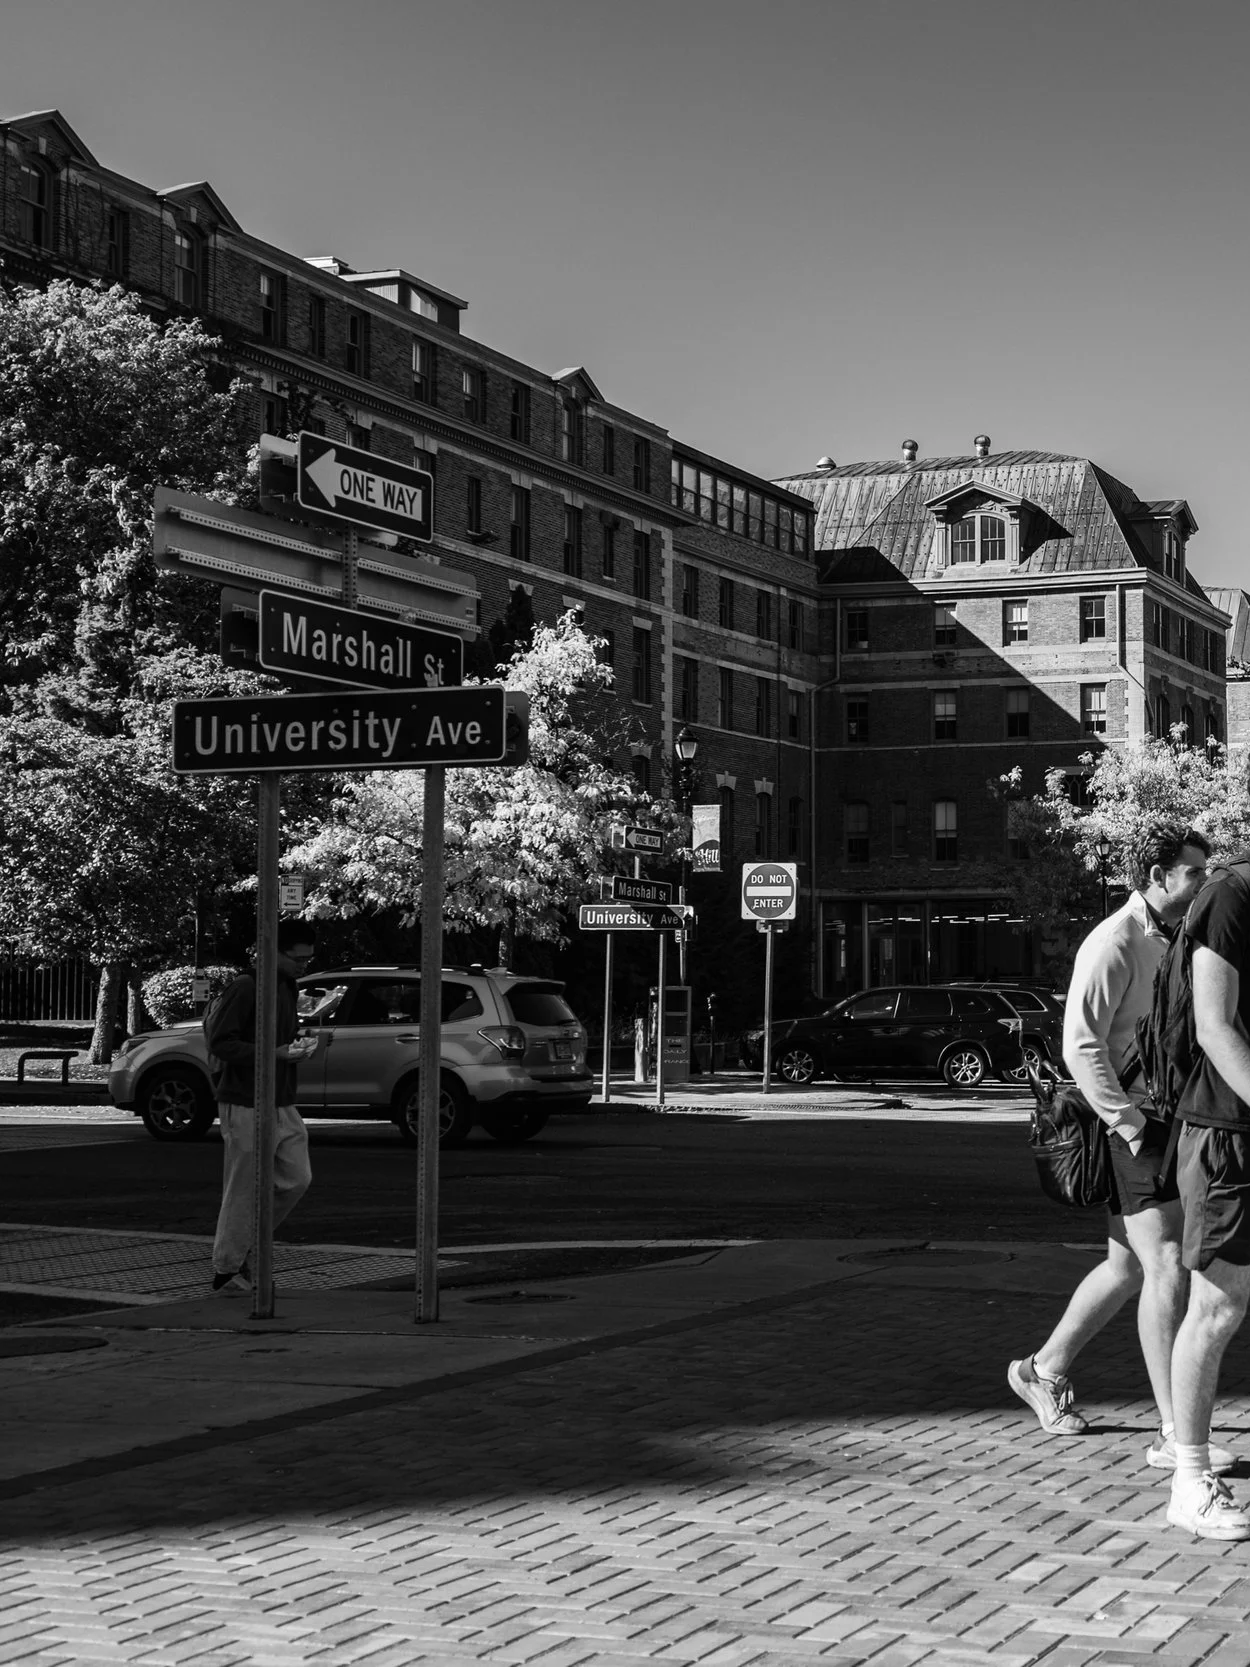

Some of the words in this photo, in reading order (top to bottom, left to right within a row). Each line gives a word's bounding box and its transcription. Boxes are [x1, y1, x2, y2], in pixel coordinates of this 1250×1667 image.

[339, 467, 376, 504] ONE
[382, 480, 418, 516] WAY
[282, 611, 412, 679] Marshall
[423, 652, 445, 686] St
[194, 709, 401, 758] University
[425, 714, 482, 747] Ave
[635, 833, 647, 846] ONE
[647, 835, 660, 848] WAY
[751, 873, 764, 884] DO
[769, 873, 787, 884] NOT
[618, 881, 657, 900] Marshall
[658, 890, 667, 902] St
[753, 898, 784, 909] ENTER
[586, 909, 654, 928] University
[660, 913, 679, 925] Ave
